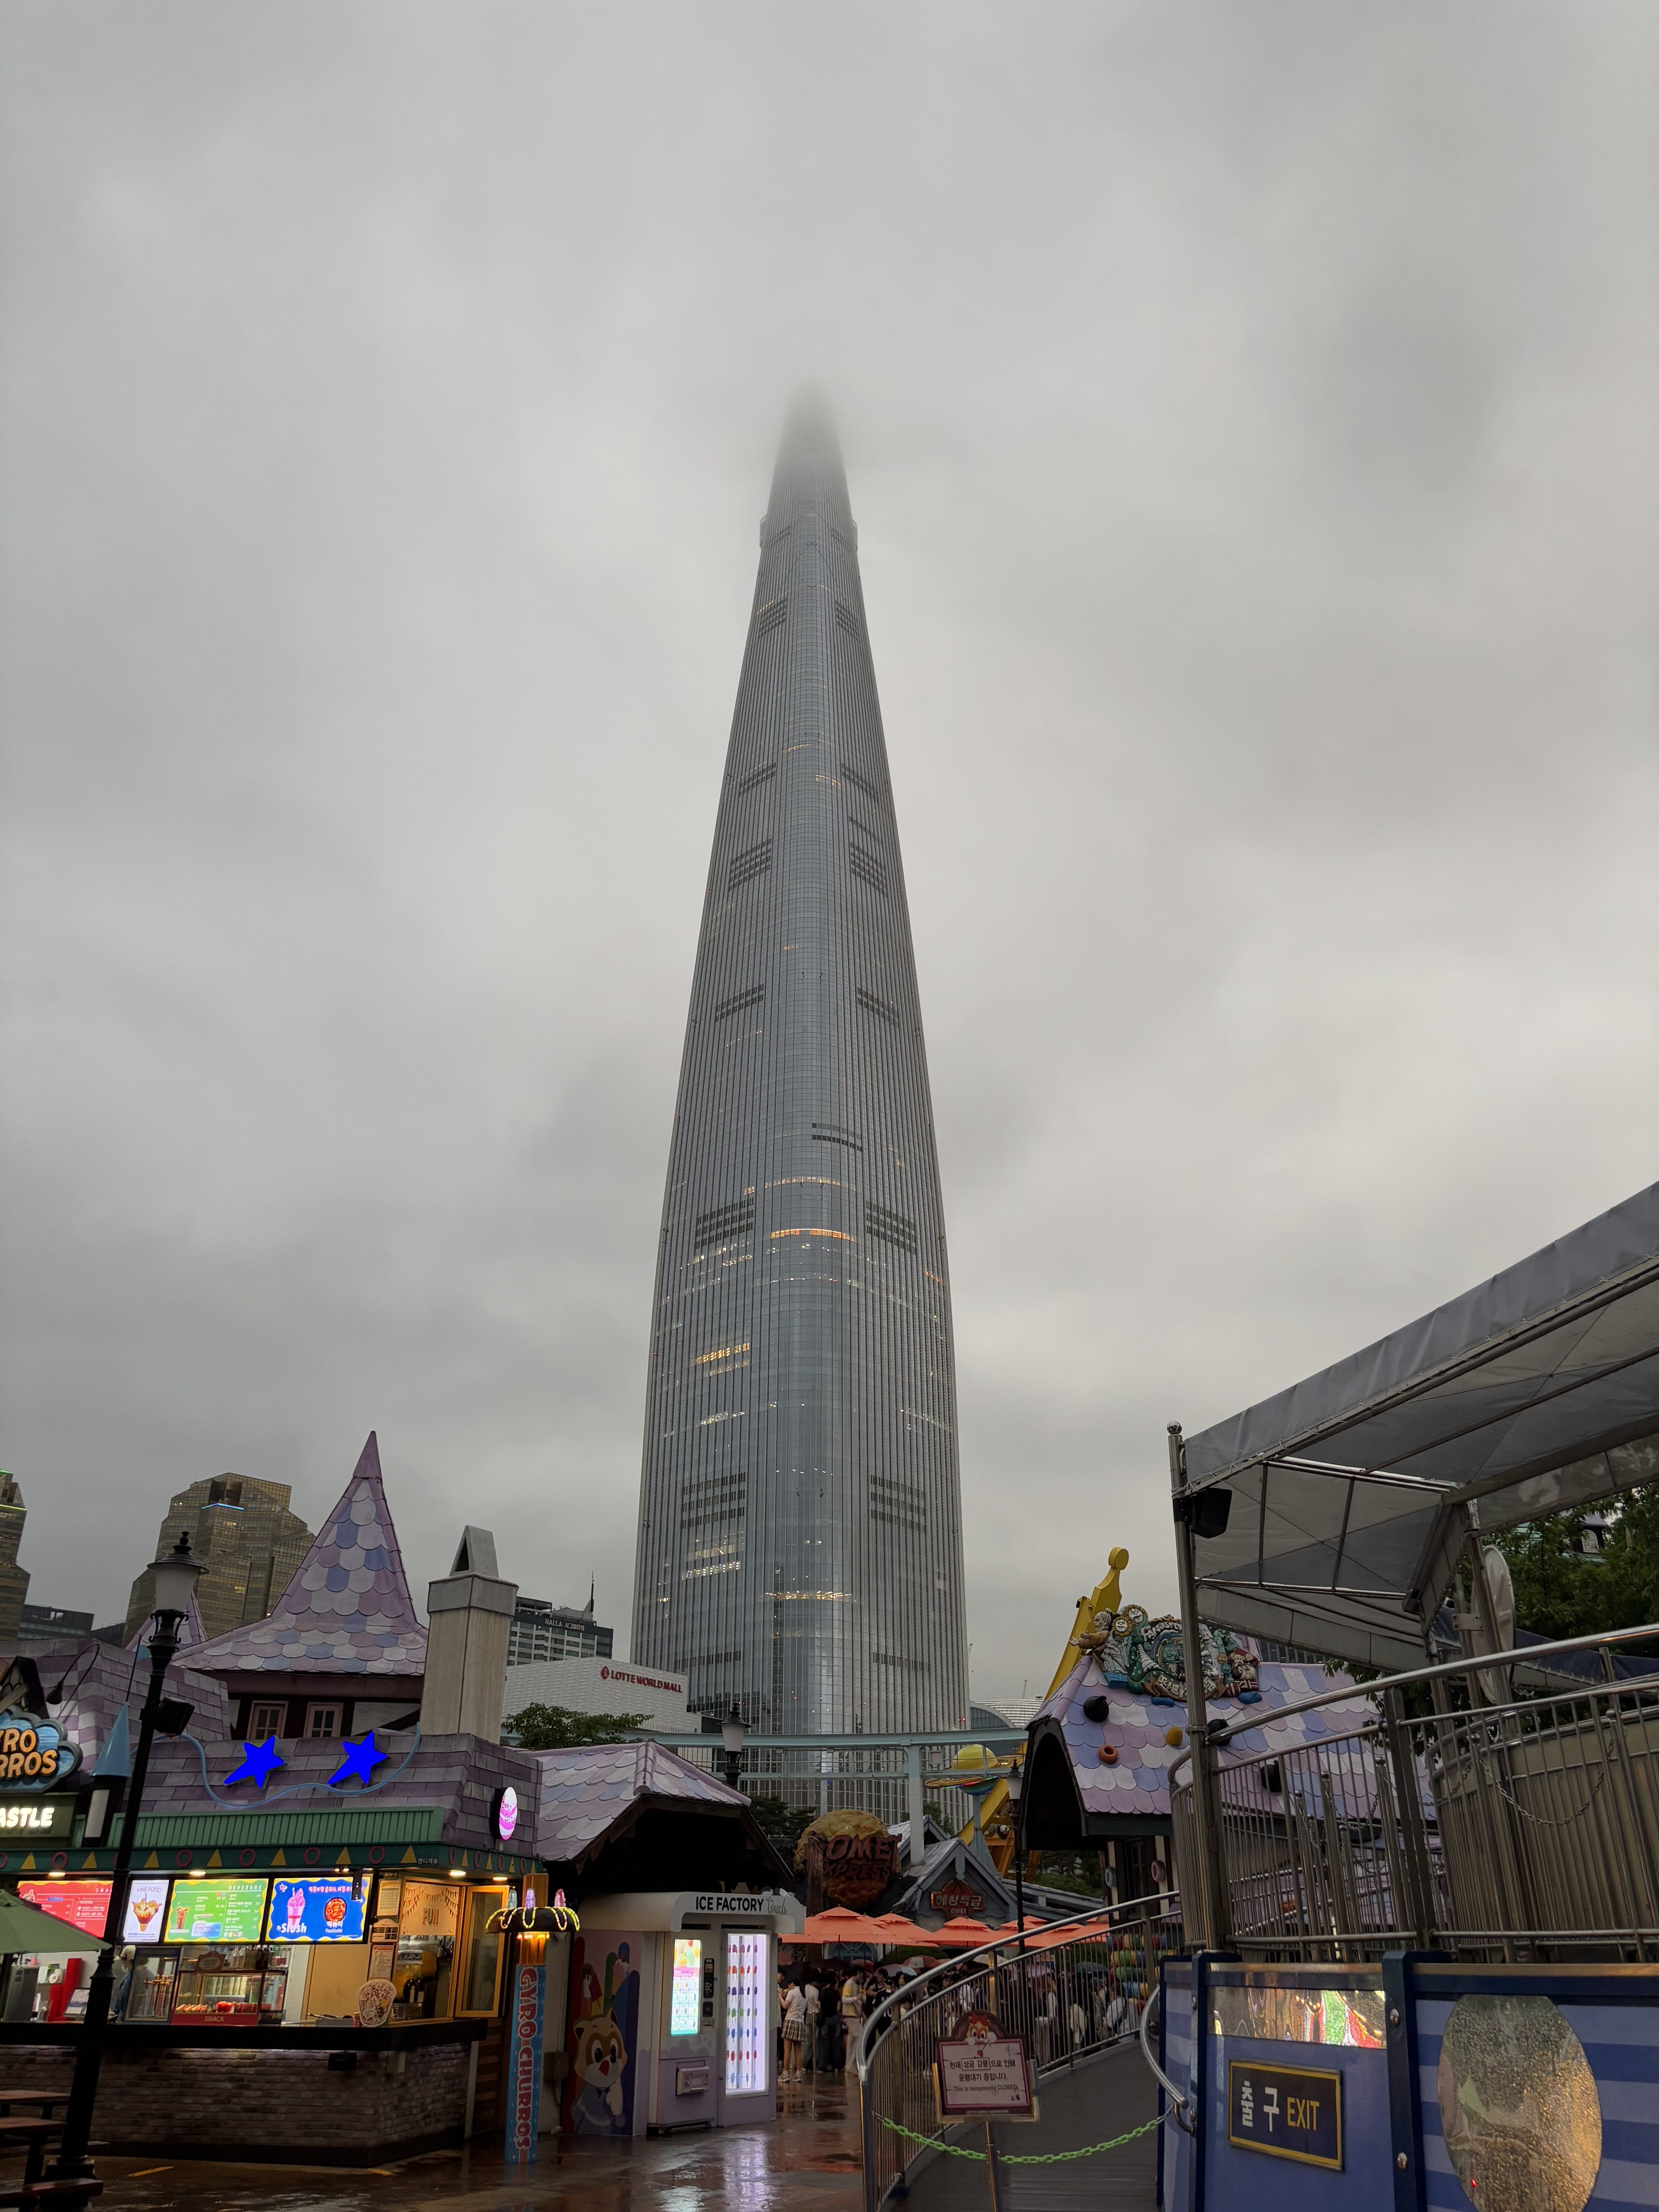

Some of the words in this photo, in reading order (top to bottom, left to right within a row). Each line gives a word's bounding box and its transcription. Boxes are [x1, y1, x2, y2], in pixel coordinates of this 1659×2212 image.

[545, 1618, 562, 1627] HALLA
[611, 1670, 635, 1683] LOTTE
[637, 1676, 663, 1688] WORLD
[663, 1682, 683, 1693] MALL
[0, 1728, 36, 1753] RO
[823, 1860, 890, 1878] XPRESS
[696, 1896, 713, 1910] ICE
[716, 1897, 764, 1911] FACTORY
[423, 1908, 439, 1926] FUN
[281, 1922, 307, 1933] Slush
[518, 1966, 538, 2040] GYRO
[516, 2045, 534, 2149] CHURROS
[1241, 2080, 1279, 2132] 출구
[1287, 2097, 1320, 2131] EXIT
